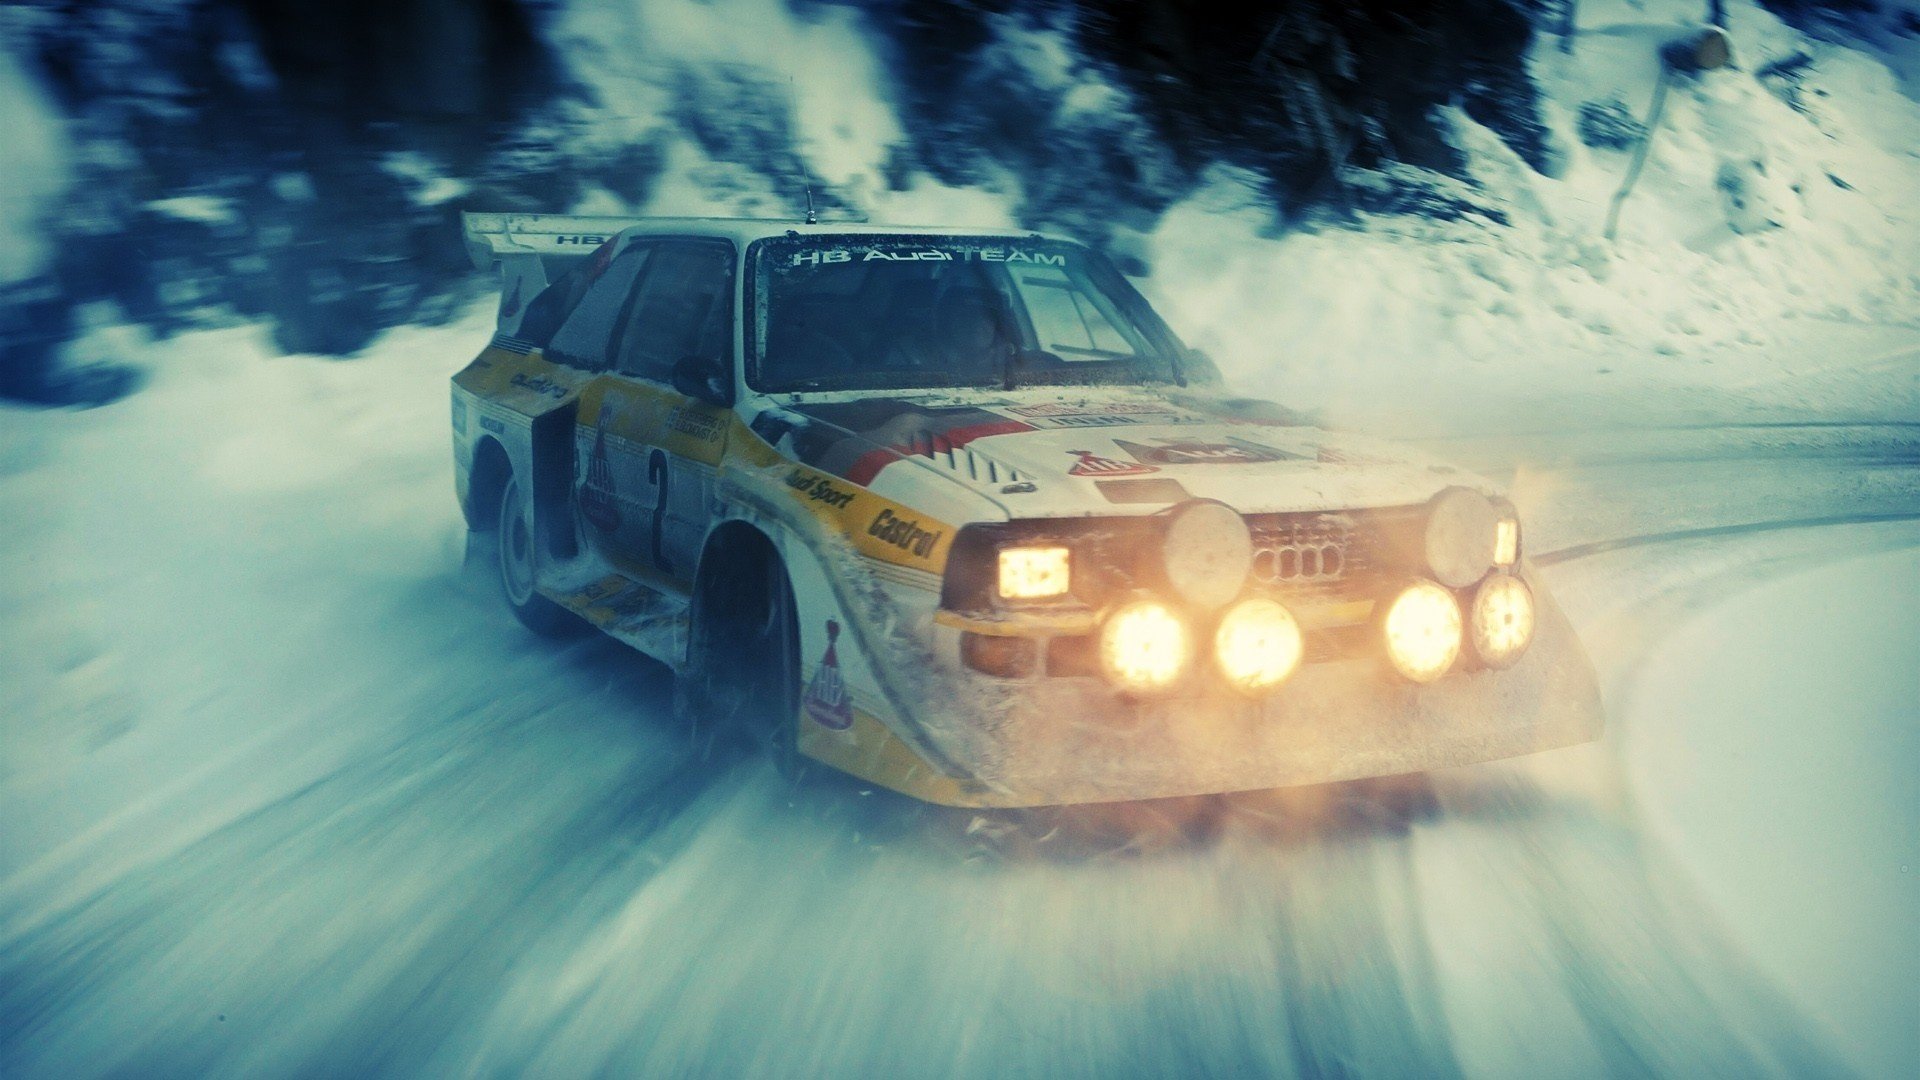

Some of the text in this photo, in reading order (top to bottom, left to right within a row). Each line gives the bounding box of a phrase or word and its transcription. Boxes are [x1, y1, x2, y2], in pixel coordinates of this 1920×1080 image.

[557, 236, 604, 245] HB
[793, 248, 1067, 267] HB Audi TEAM
[809, 480, 857, 509] Sport
[648, 448, 677, 576] 2
[868, 508, 943, 559] Castrol
